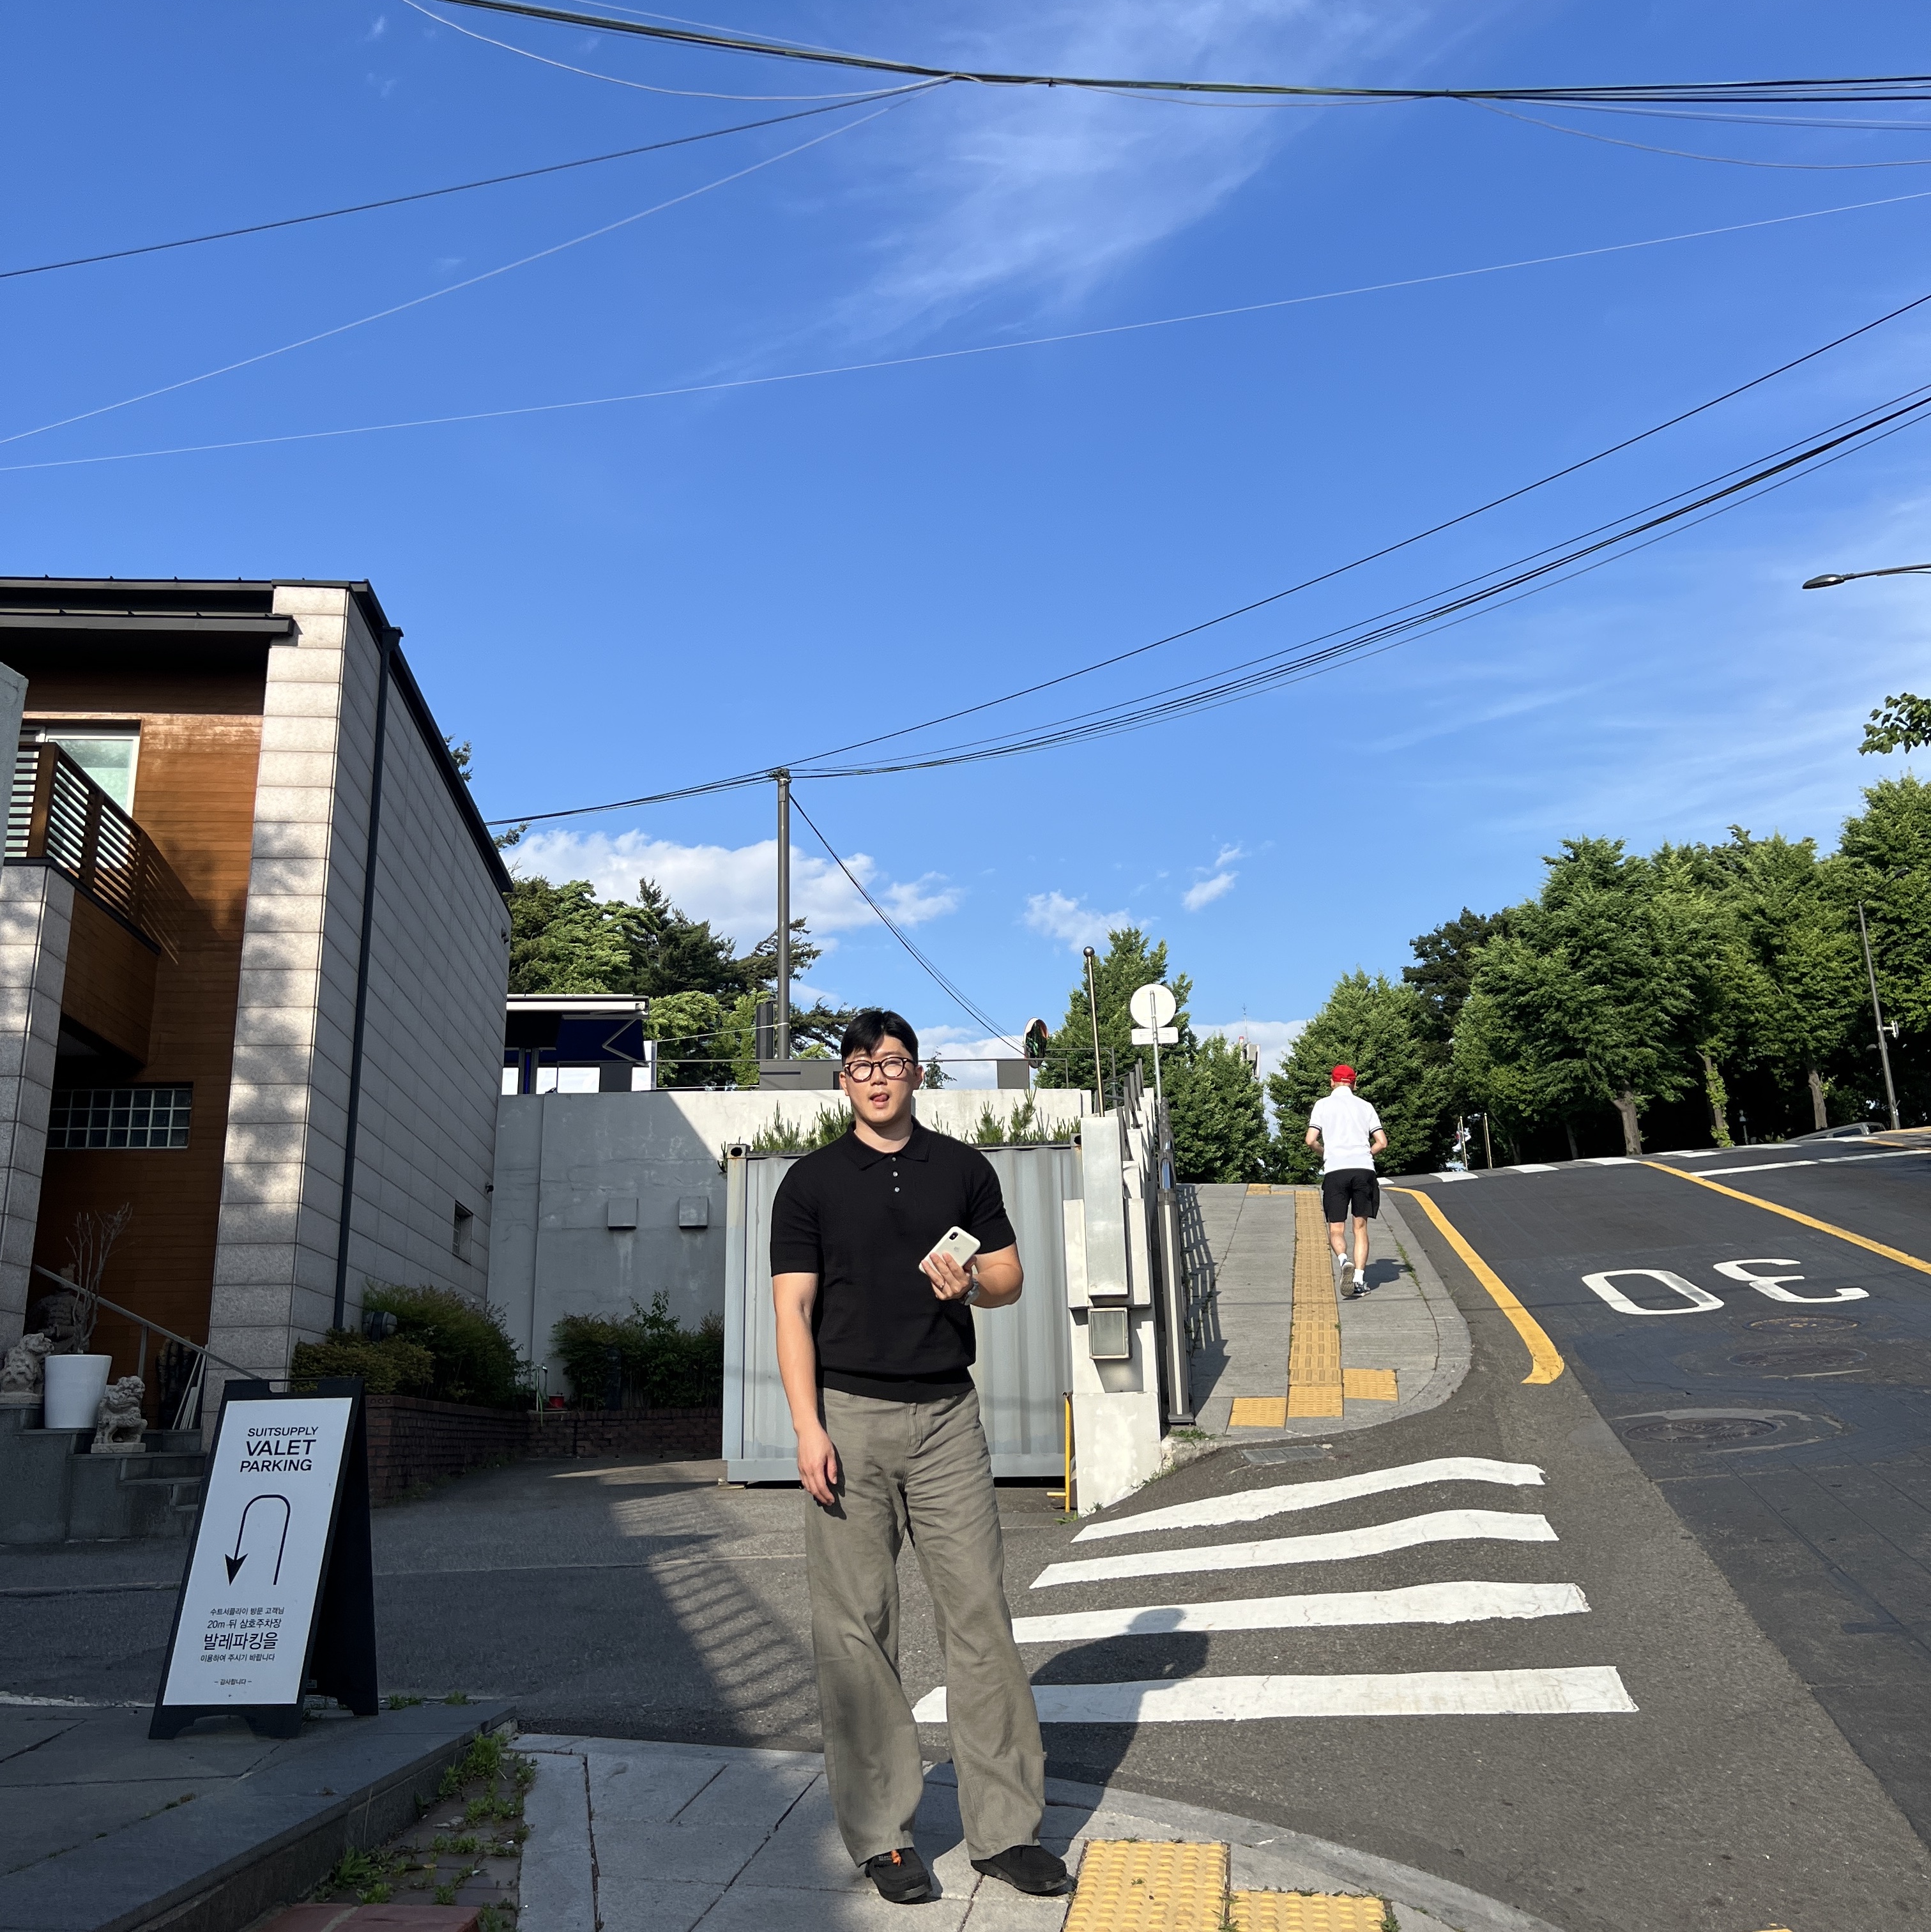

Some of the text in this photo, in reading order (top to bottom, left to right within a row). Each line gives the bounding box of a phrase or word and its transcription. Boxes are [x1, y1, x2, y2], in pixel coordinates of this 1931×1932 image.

[1582, 1258, 1870, 1316] 30
[247, 1426, 319, 1437] SUITSUPPLY
[246, 1439, 317, 1456] VALET
[240, 1459, 312, 1473] PARKING
[210, 1606, 285, 1616] 수트서플라이 방문 고객님
[207, 1618, 282, 1629] 20m 뒤 삼호주차장
[204, 1632, 279, 1650] 발레파킹을
[200, 1653, 275, 1662] 이용하여 주시기 바랍니다
